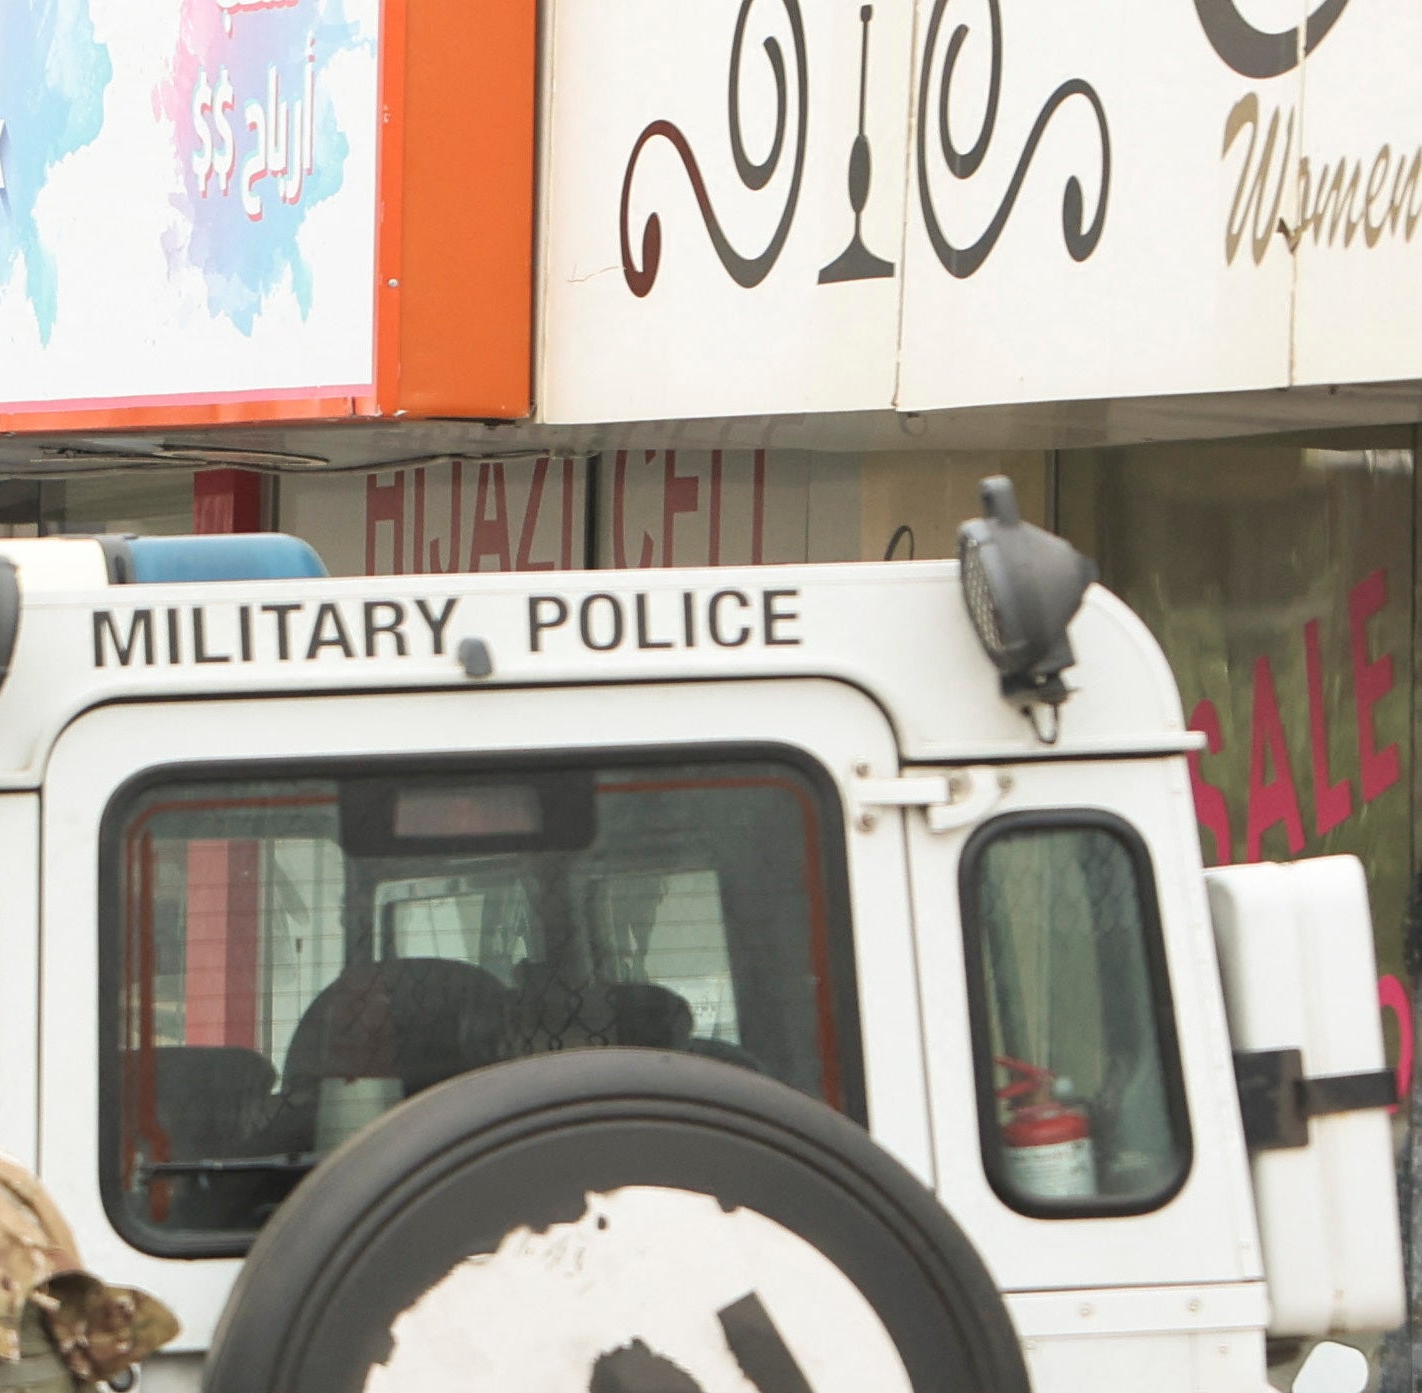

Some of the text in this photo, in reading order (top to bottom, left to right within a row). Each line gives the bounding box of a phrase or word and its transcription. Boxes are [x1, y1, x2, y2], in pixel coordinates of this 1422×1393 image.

[242, 29, 315, 220] أرباح
[92, 588, 804, 668] MILITARY POLICE
[1187, 567, 1402, 866] SALE
